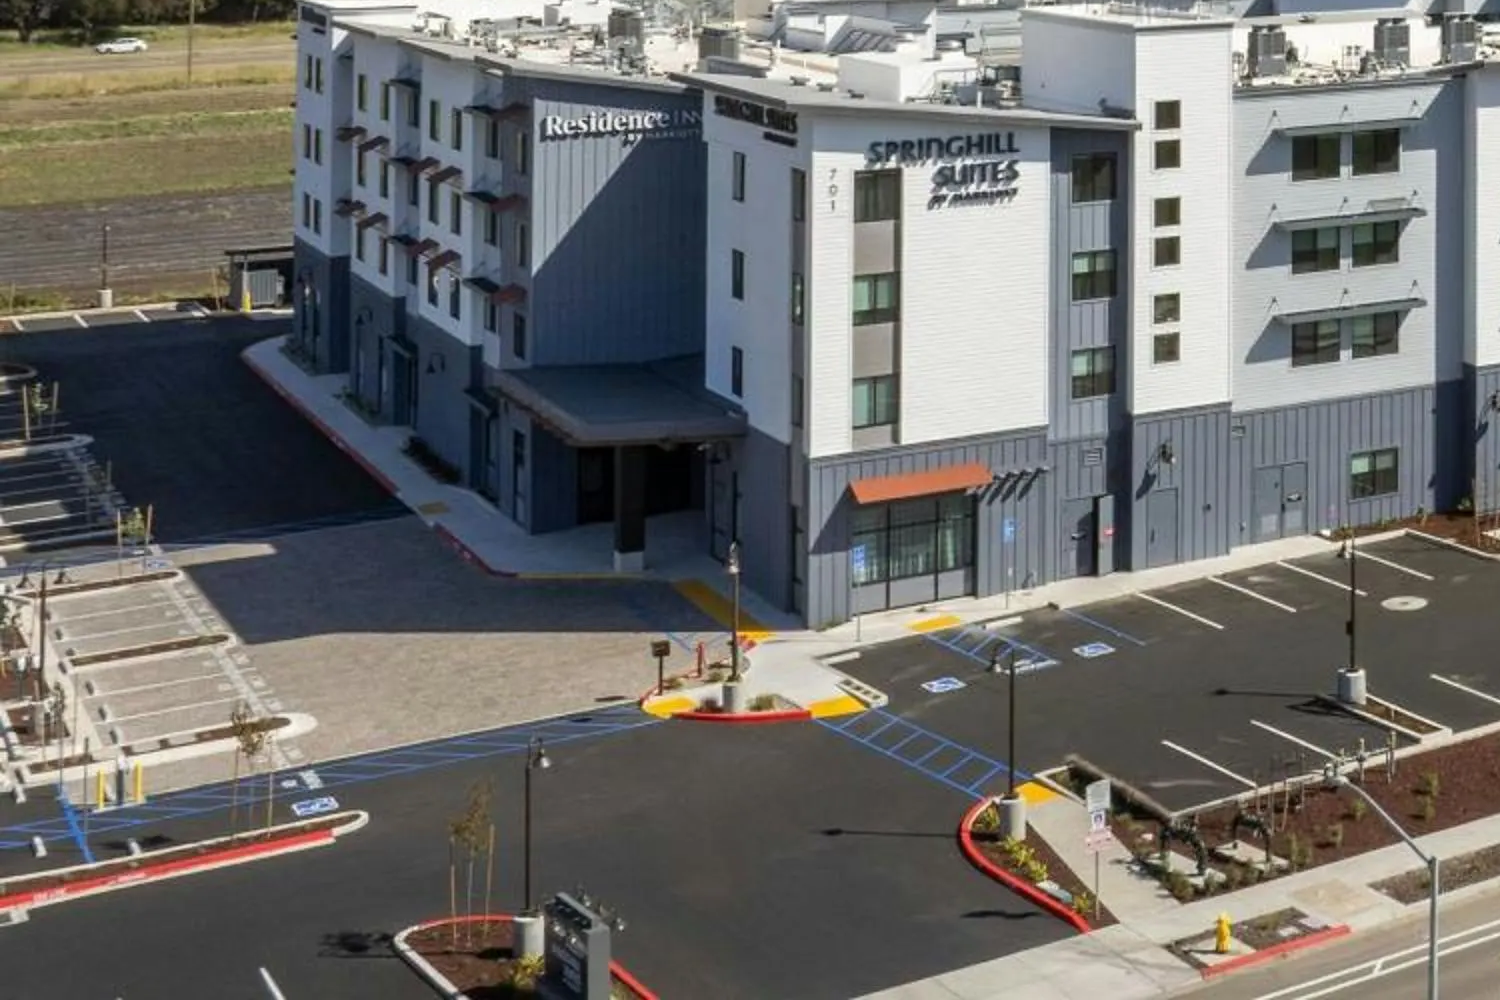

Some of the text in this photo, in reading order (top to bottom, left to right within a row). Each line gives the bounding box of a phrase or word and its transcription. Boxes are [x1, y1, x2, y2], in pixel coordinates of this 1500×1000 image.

[545, 110, 671, 138] Residence
[868, 131, 1021, 164] SPRINGHILL
[931, 159, 1020, 187] SUITES
